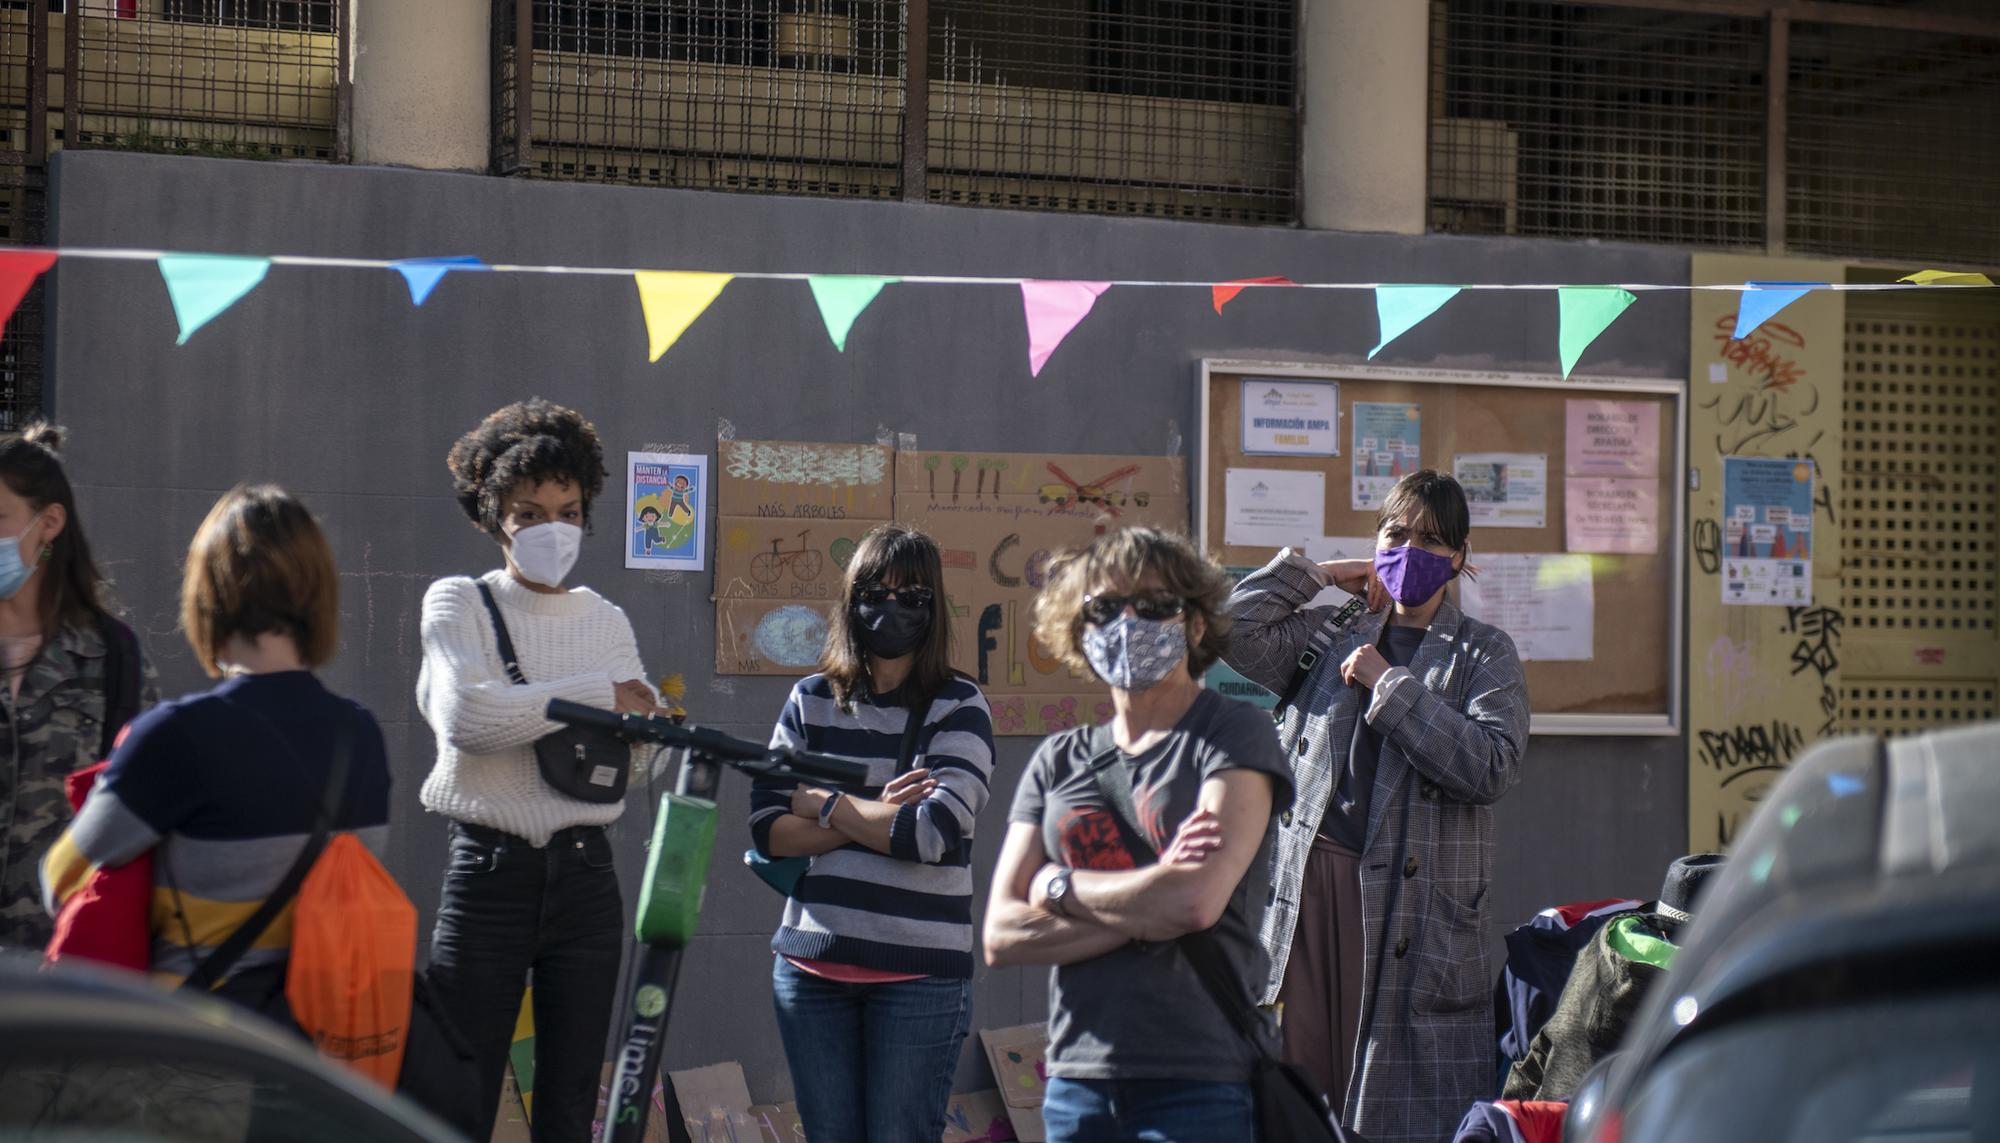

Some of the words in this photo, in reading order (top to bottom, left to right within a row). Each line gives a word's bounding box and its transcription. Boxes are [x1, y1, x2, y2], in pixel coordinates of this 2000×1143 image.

[1253, 417, 1305, 430] INFORMACIÓN
[1307, 419, 1330, 430] AMPA
[635, 475, 668, 486] DISTANCIA
